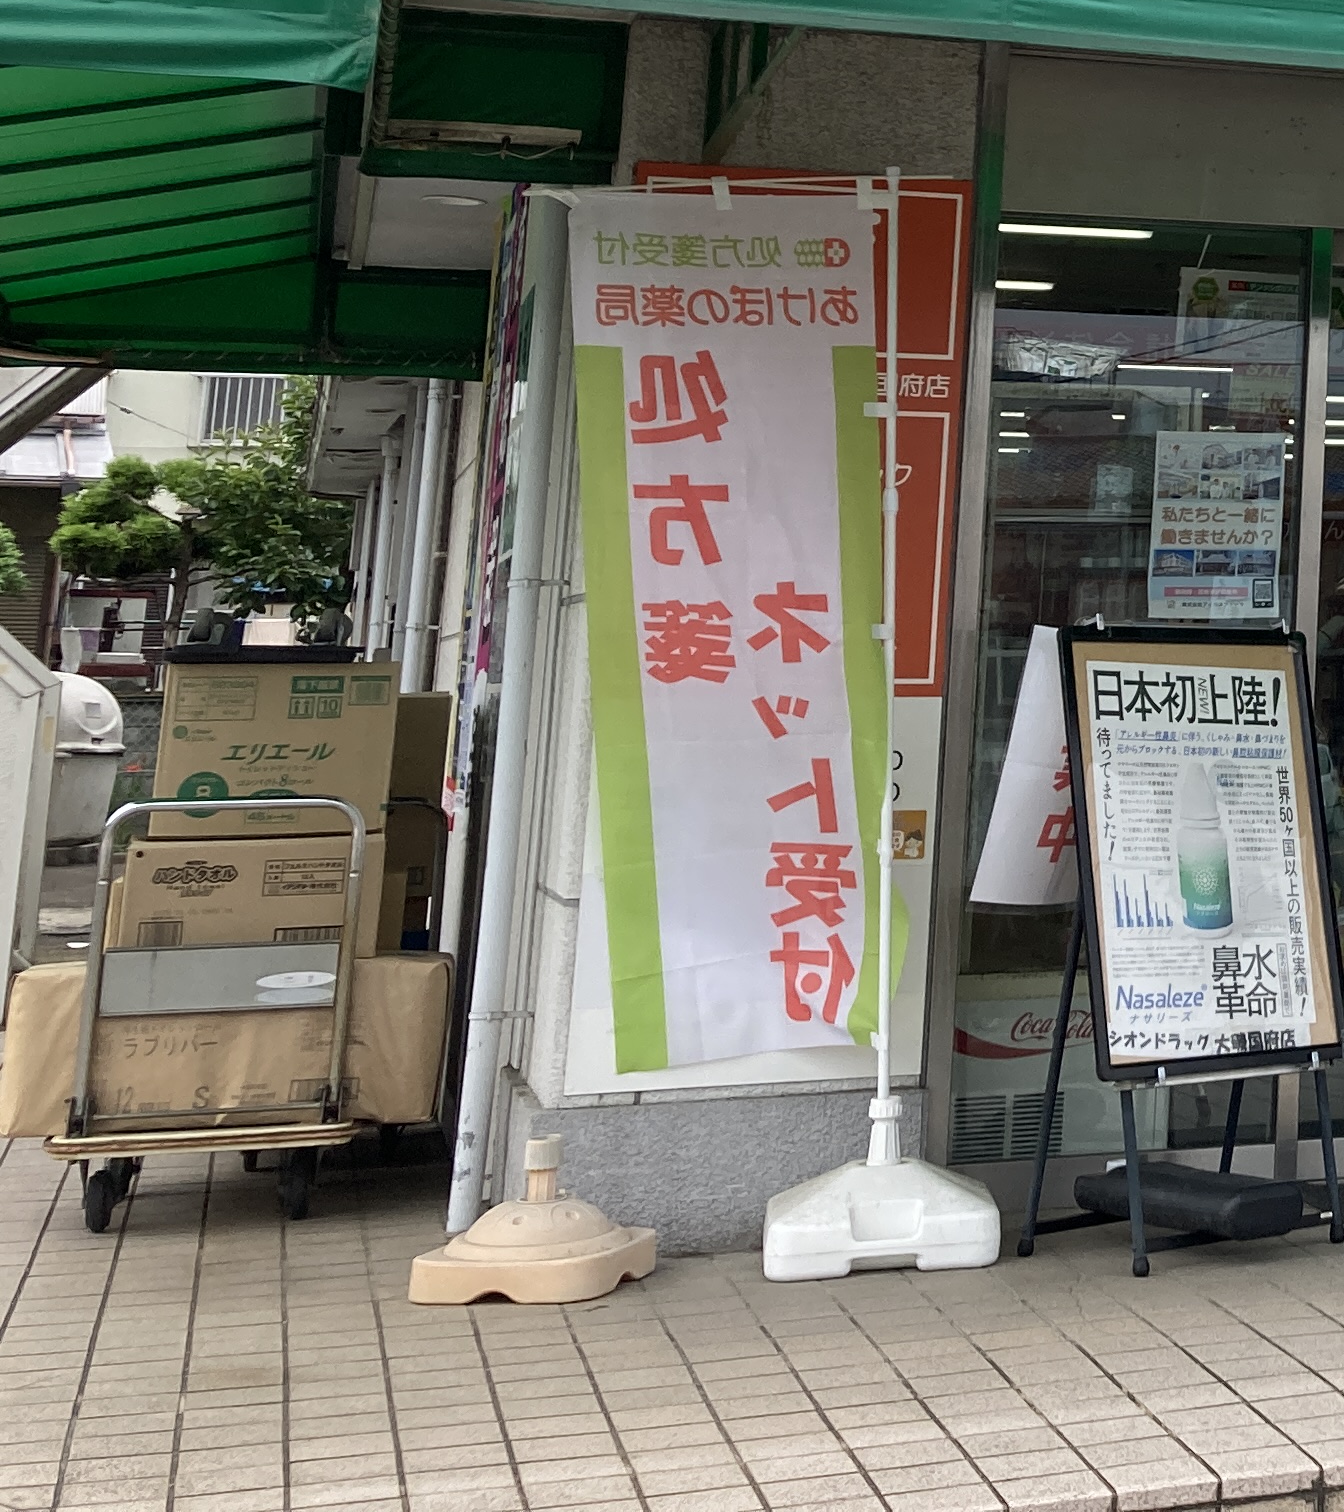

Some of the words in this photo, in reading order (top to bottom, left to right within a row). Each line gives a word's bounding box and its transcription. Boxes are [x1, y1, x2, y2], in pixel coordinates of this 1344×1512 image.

[1161, 506, 1276, 524] 私たちと一緒に
[1092, 669, 1282, 729] 日本初上陸!
[220, 742, 336, 765] エリエール
[1212, 944, 1277, 982] 鼻水
[1115, 983, 1205, 1011] Nasaleze
[1212, 982, 1278, 1020] 革命
[1129, 1010, 1194, 1024] ナサリーズ
